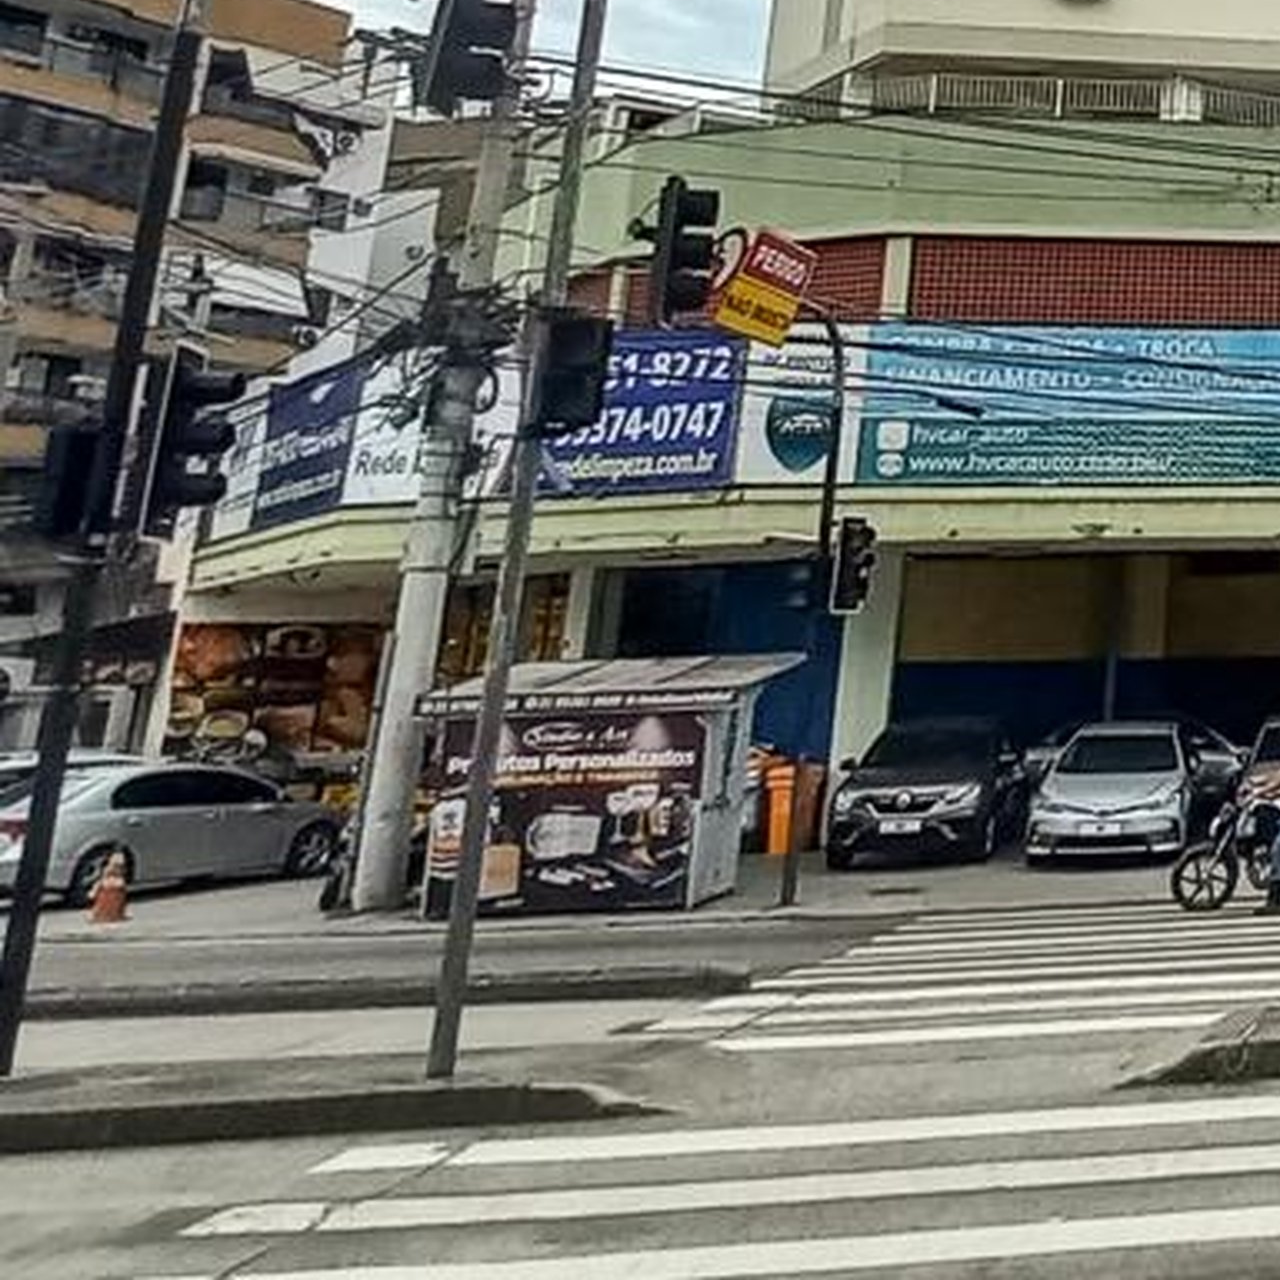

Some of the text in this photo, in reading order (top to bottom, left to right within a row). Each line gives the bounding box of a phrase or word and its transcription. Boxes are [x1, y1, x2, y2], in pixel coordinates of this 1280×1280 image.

[1137, 339, 1216, 357] TROCA
[603, 346, 732, 389] 51-8272
[552, 402, 725, 447] 374-0747
[354, 448, 406, 476] Rede
[446, 753, 541, 775] Prutos
